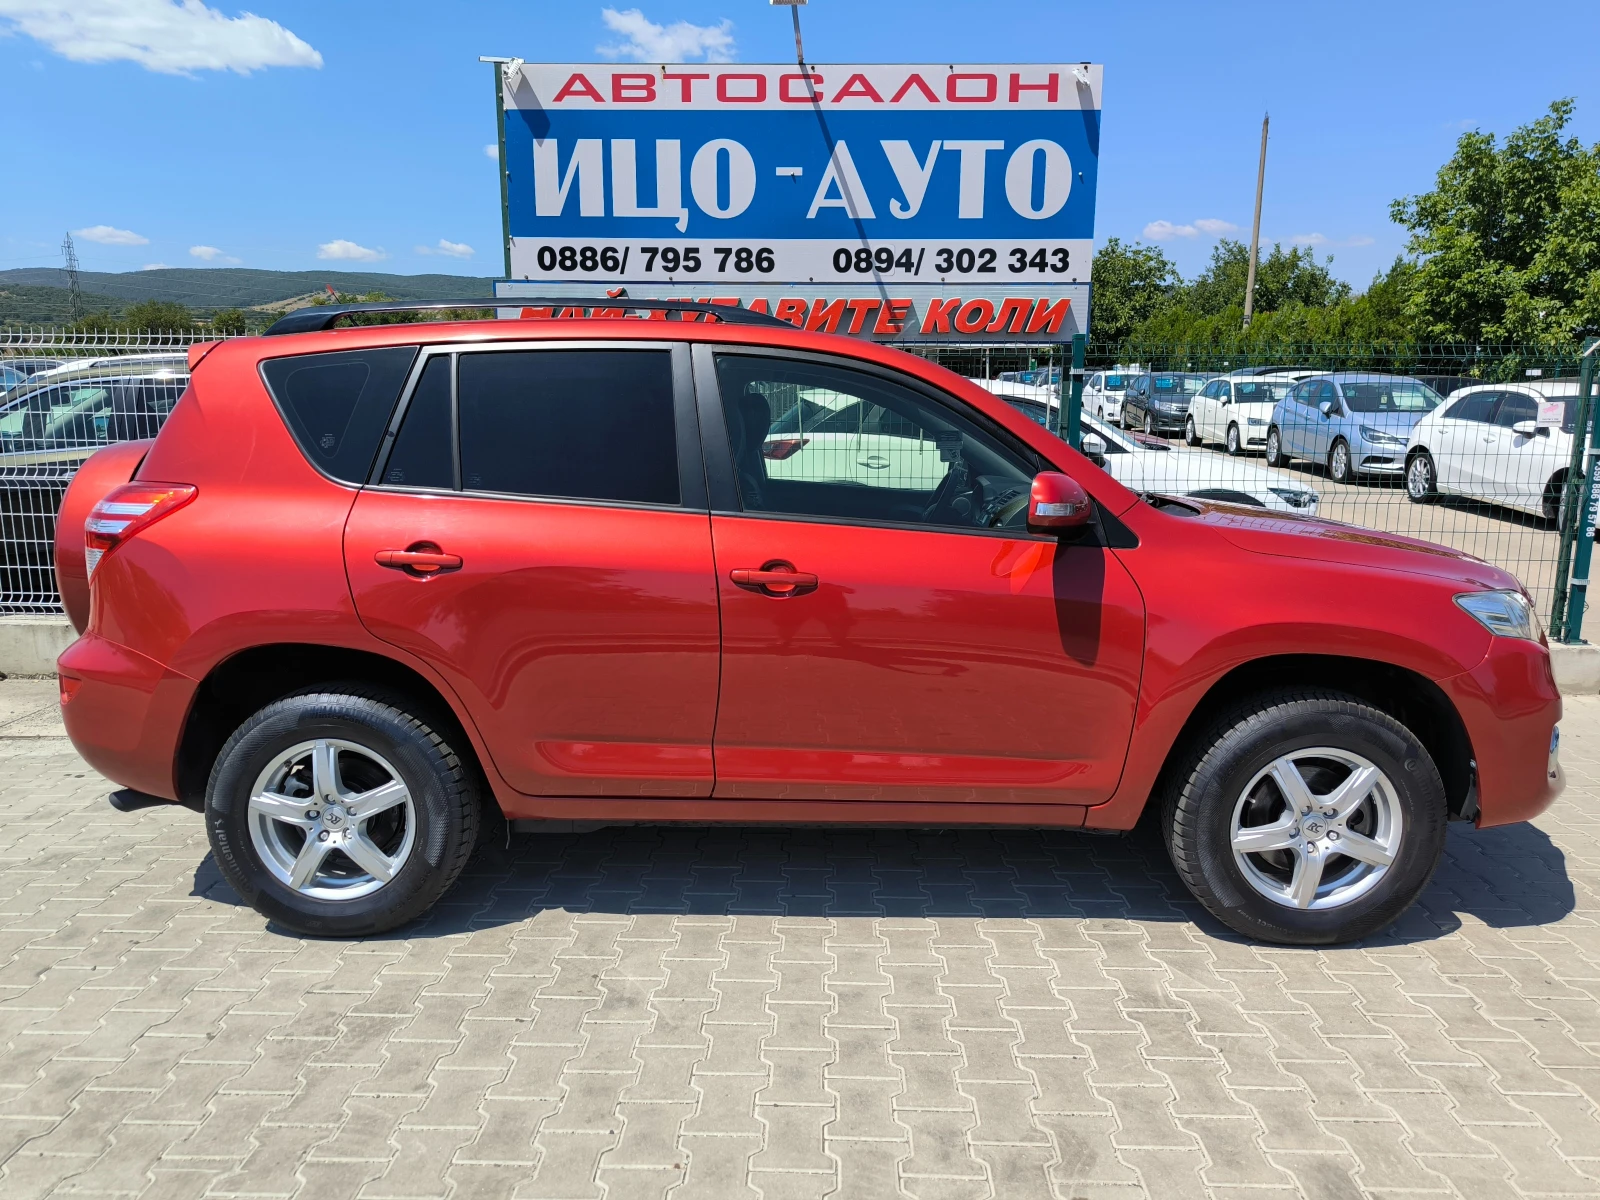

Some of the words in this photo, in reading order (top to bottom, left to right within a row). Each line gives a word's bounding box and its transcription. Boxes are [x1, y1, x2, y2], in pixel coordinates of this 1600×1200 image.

[552, 73, 1060, 104] АВТОСАЛОН
[533, 138, 757, 233] ИЦО
[537, 246, 629, 274] 0886/
[641, 247, 702, 273] 795
[716, 248, 775, 273] 786
[832, 248, 925, 276] 0894/
[935, 249, 997, 274] 302
[1008, 248, 1070, 273] 343
[921, 298, 1071, 334] КОЛИ
[1586, 527, 1596, 537] 86
